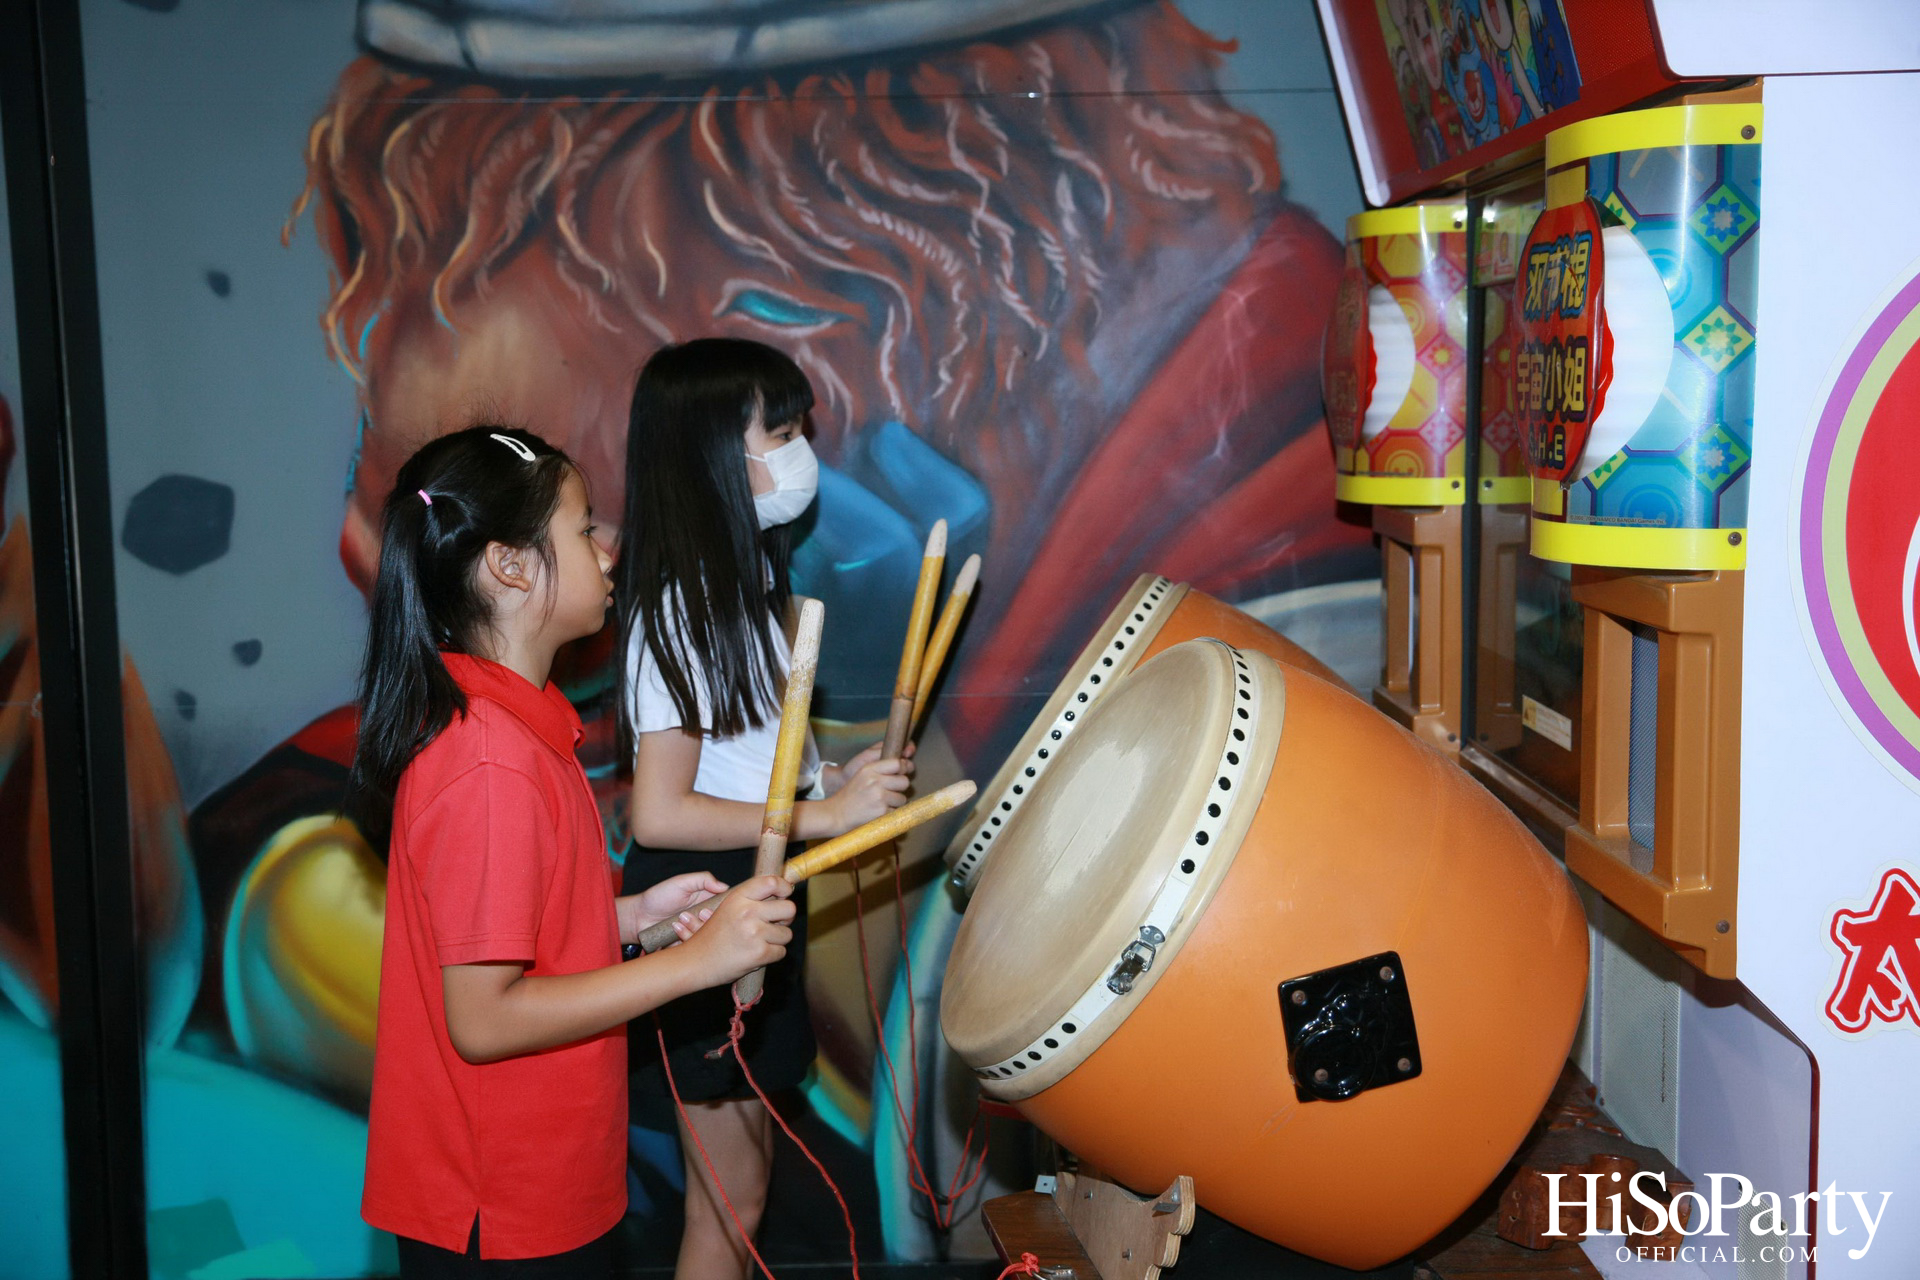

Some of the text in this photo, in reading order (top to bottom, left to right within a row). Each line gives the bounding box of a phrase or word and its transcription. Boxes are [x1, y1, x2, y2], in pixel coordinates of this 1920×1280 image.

[1525, 238, 1591, 311] 双节棍
[1517, 344, 1587, 414] 宇宙小姐
